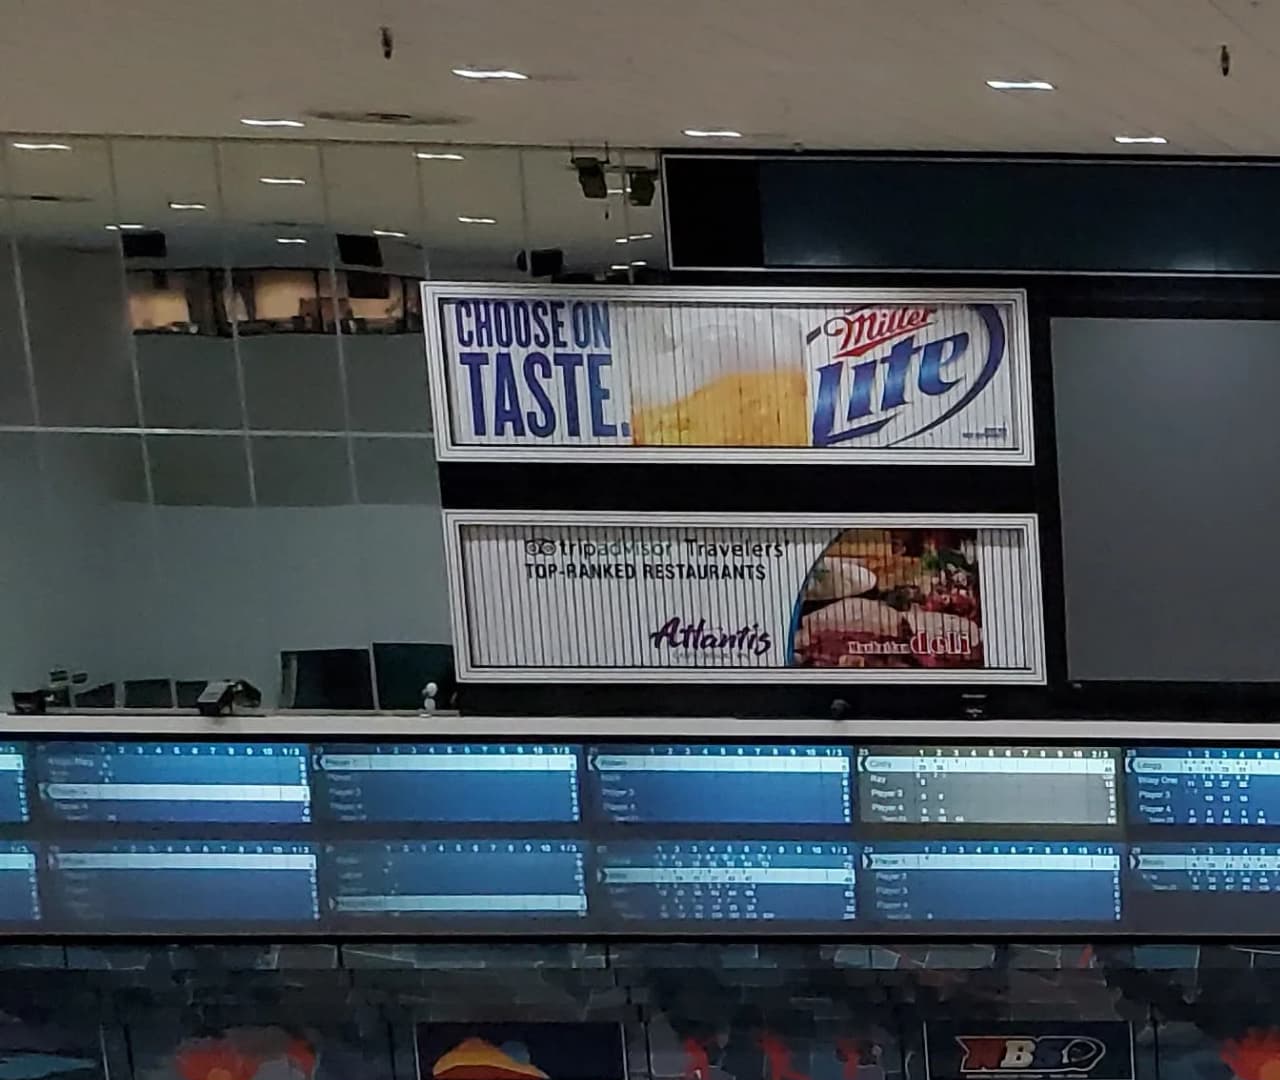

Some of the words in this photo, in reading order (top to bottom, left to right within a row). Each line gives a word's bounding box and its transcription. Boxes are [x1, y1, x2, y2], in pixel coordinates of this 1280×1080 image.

[455, 300, 567, 348] CHOOSE
[572, 301, 611, 348] ON
[824, 307, 939, 351] Miller
[459, 352, 631, 437] TASTE.
[812, 332, 969, 447] Lite
[525, 563, 636, 580] TOP-RANKED
[643, 564, 766, 581] RESTAURANTS
[650, 617, 772, 656] Atlantis
